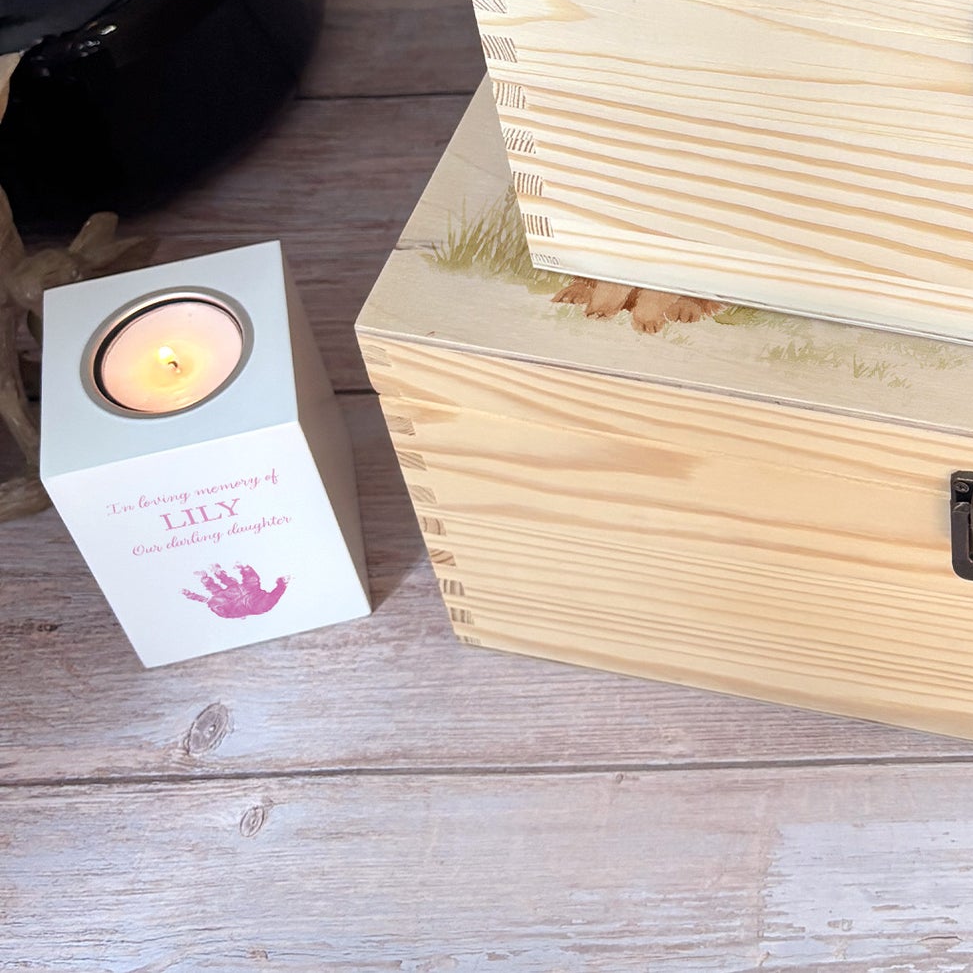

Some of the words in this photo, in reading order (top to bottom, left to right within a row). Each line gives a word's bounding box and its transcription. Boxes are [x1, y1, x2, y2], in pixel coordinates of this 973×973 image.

[106, 502, 135, 516] In
[138, 491, 191, 510] loving
[194, 476, 261, 496] memory
[264, 467, 280, 486] of
[132, 542, 163, 557] Our
[166, 530, 224, 551] darling
[226, 514, 293, 536] daughter
[160, 497, 241, 531] LILY
